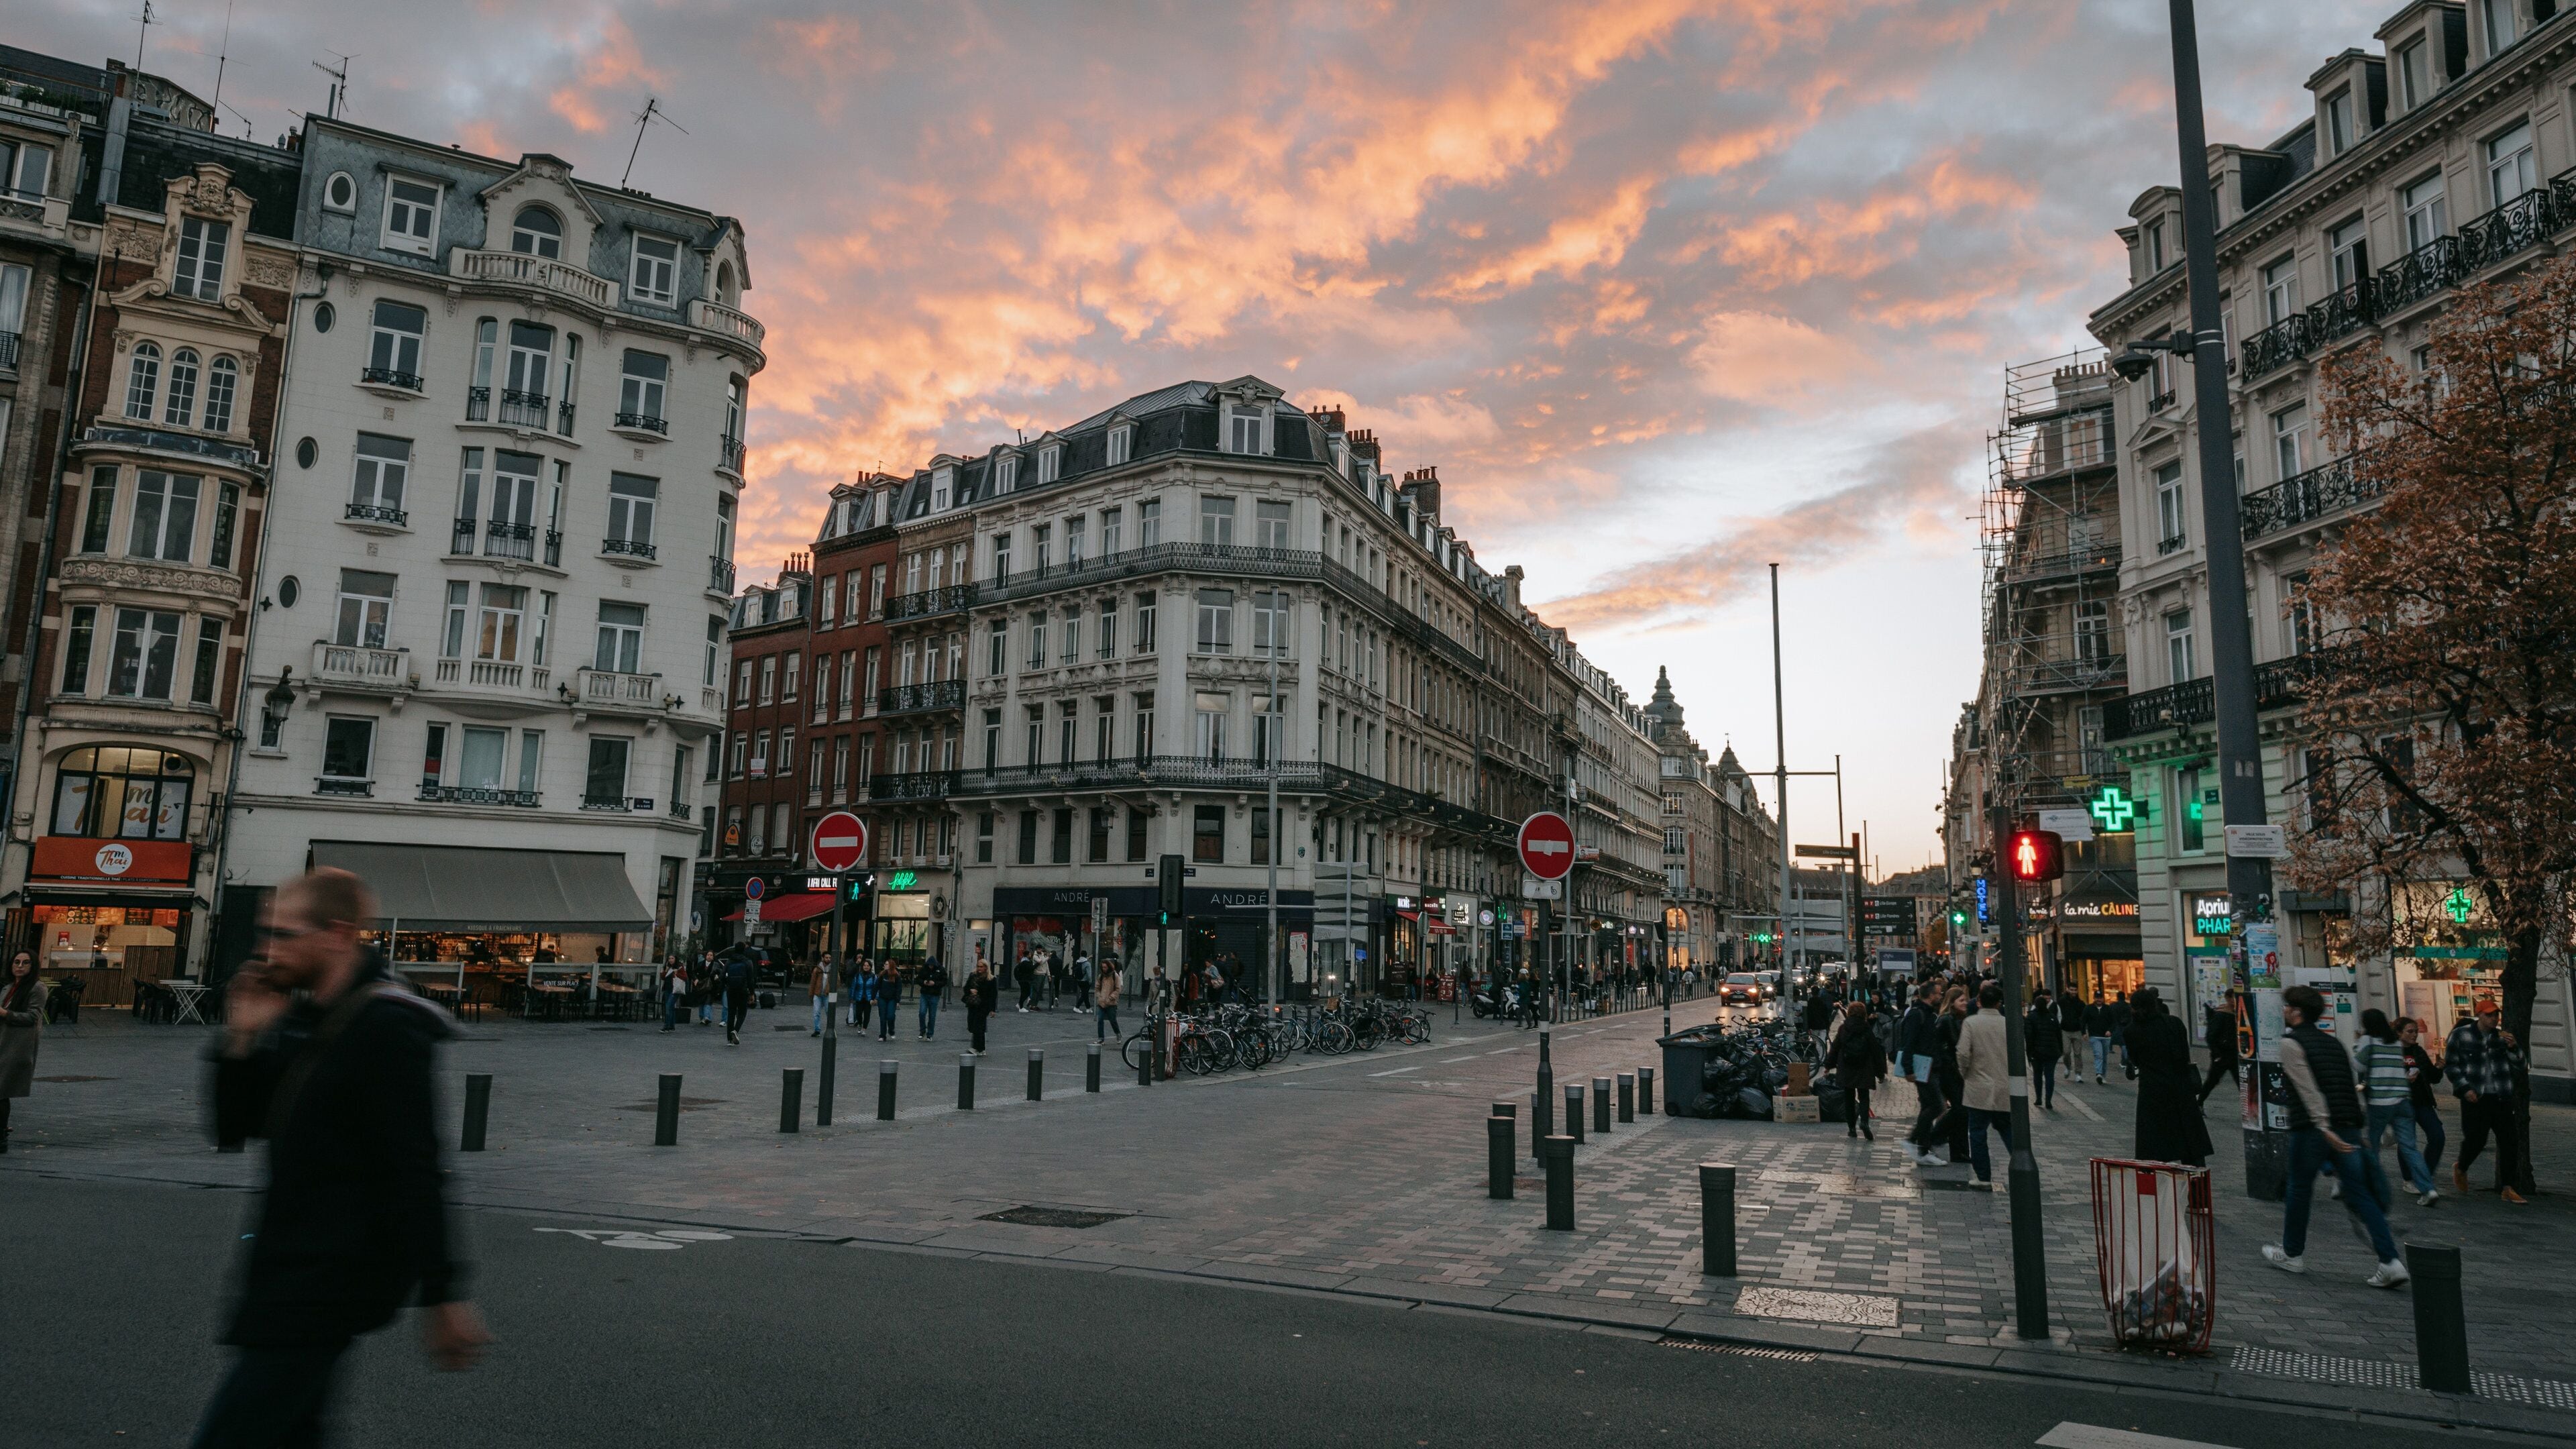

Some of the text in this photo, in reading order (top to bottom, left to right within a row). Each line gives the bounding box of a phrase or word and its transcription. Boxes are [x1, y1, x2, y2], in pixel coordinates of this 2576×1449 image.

[1054, 889, 1089, 902] ANDRÉ
[1210, 892, 1267, 905] ANDRÉ
[2078, 903, 2101, 915] mie
[2100, 902, 2139, 916] CÂLINE
